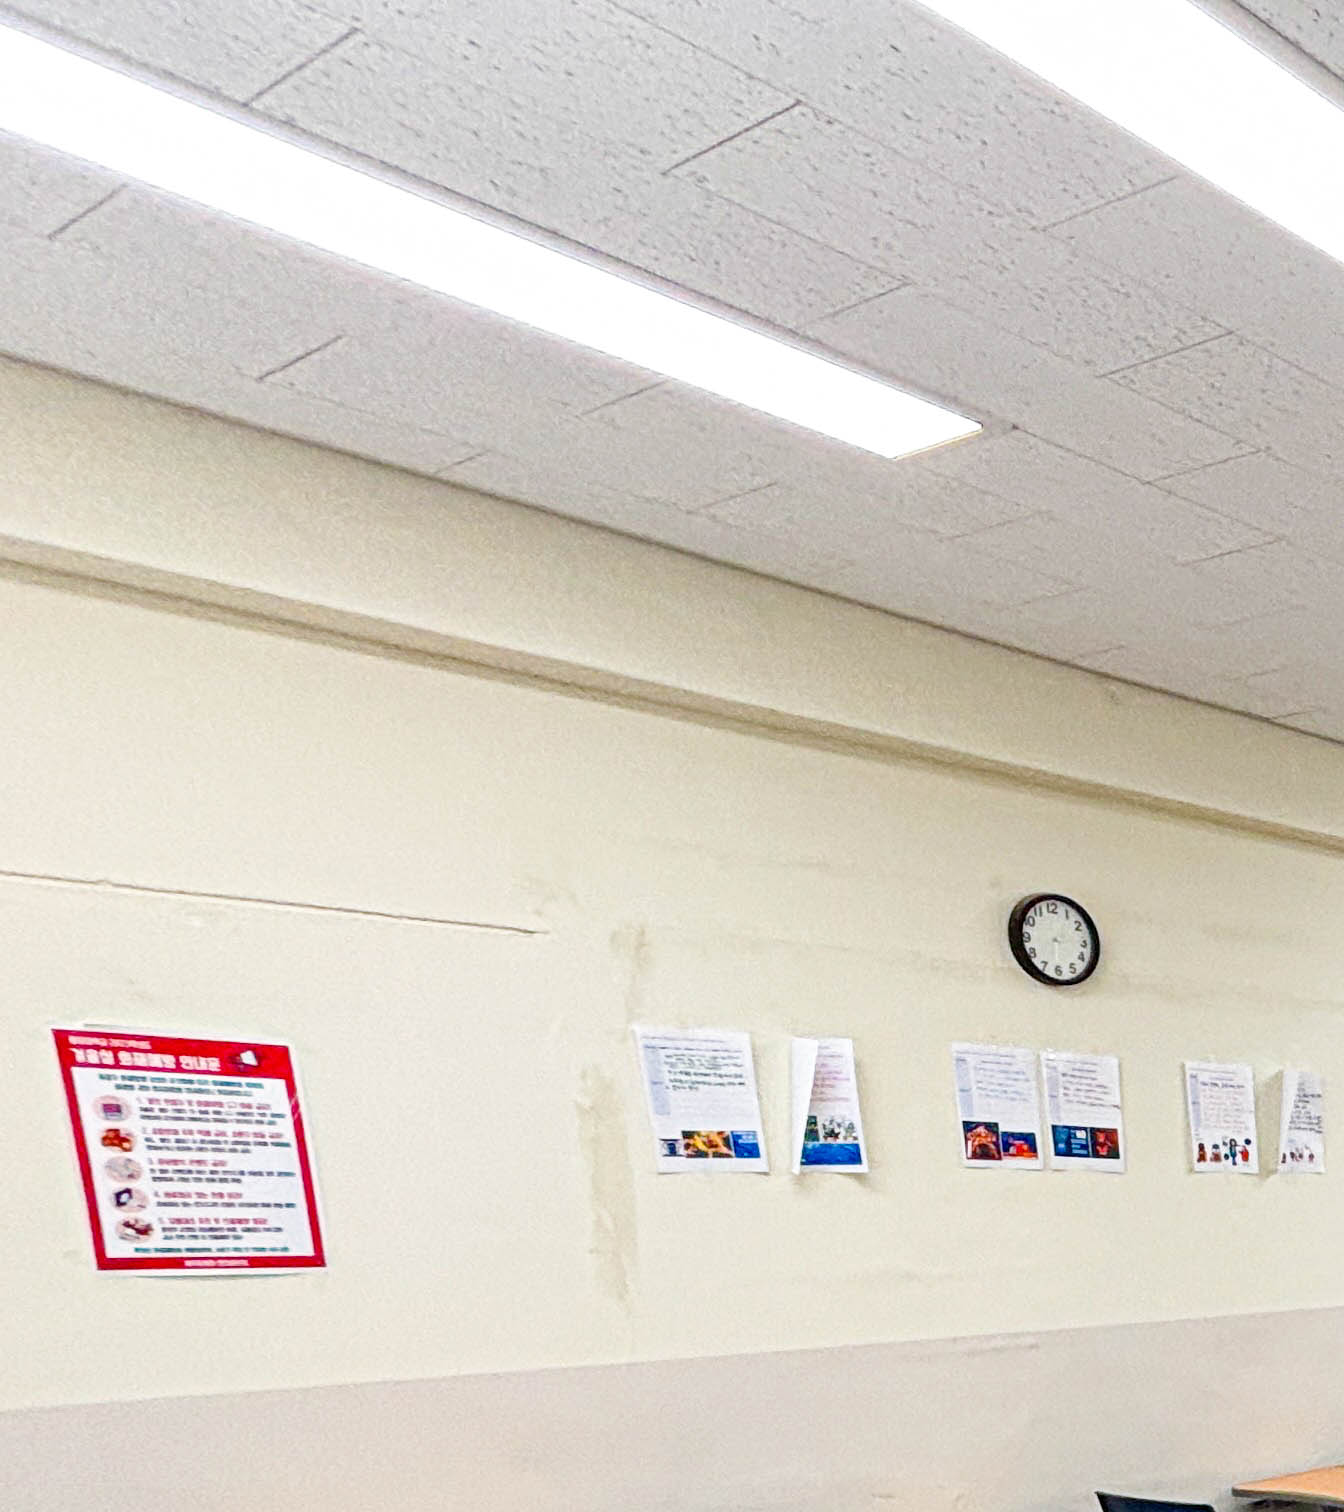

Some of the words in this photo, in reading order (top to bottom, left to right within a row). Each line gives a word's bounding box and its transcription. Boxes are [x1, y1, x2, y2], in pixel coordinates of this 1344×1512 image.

[1034, 906, 1043, 917] 11
[1047, 903, 1058, 914] 12
[1074, 921, 1082, 932] 2
[1022, 931, 1031, 943] 9
[1080, 937, 1088, 949] 3
[1028, 947, 1037, 958] 8
[1078, 951, 1085, 962] 4
[1040, 960, 1048, 972] 7
[1054, 965, 1063, 977] 6
[1069, 963, 1077, 974] 5
